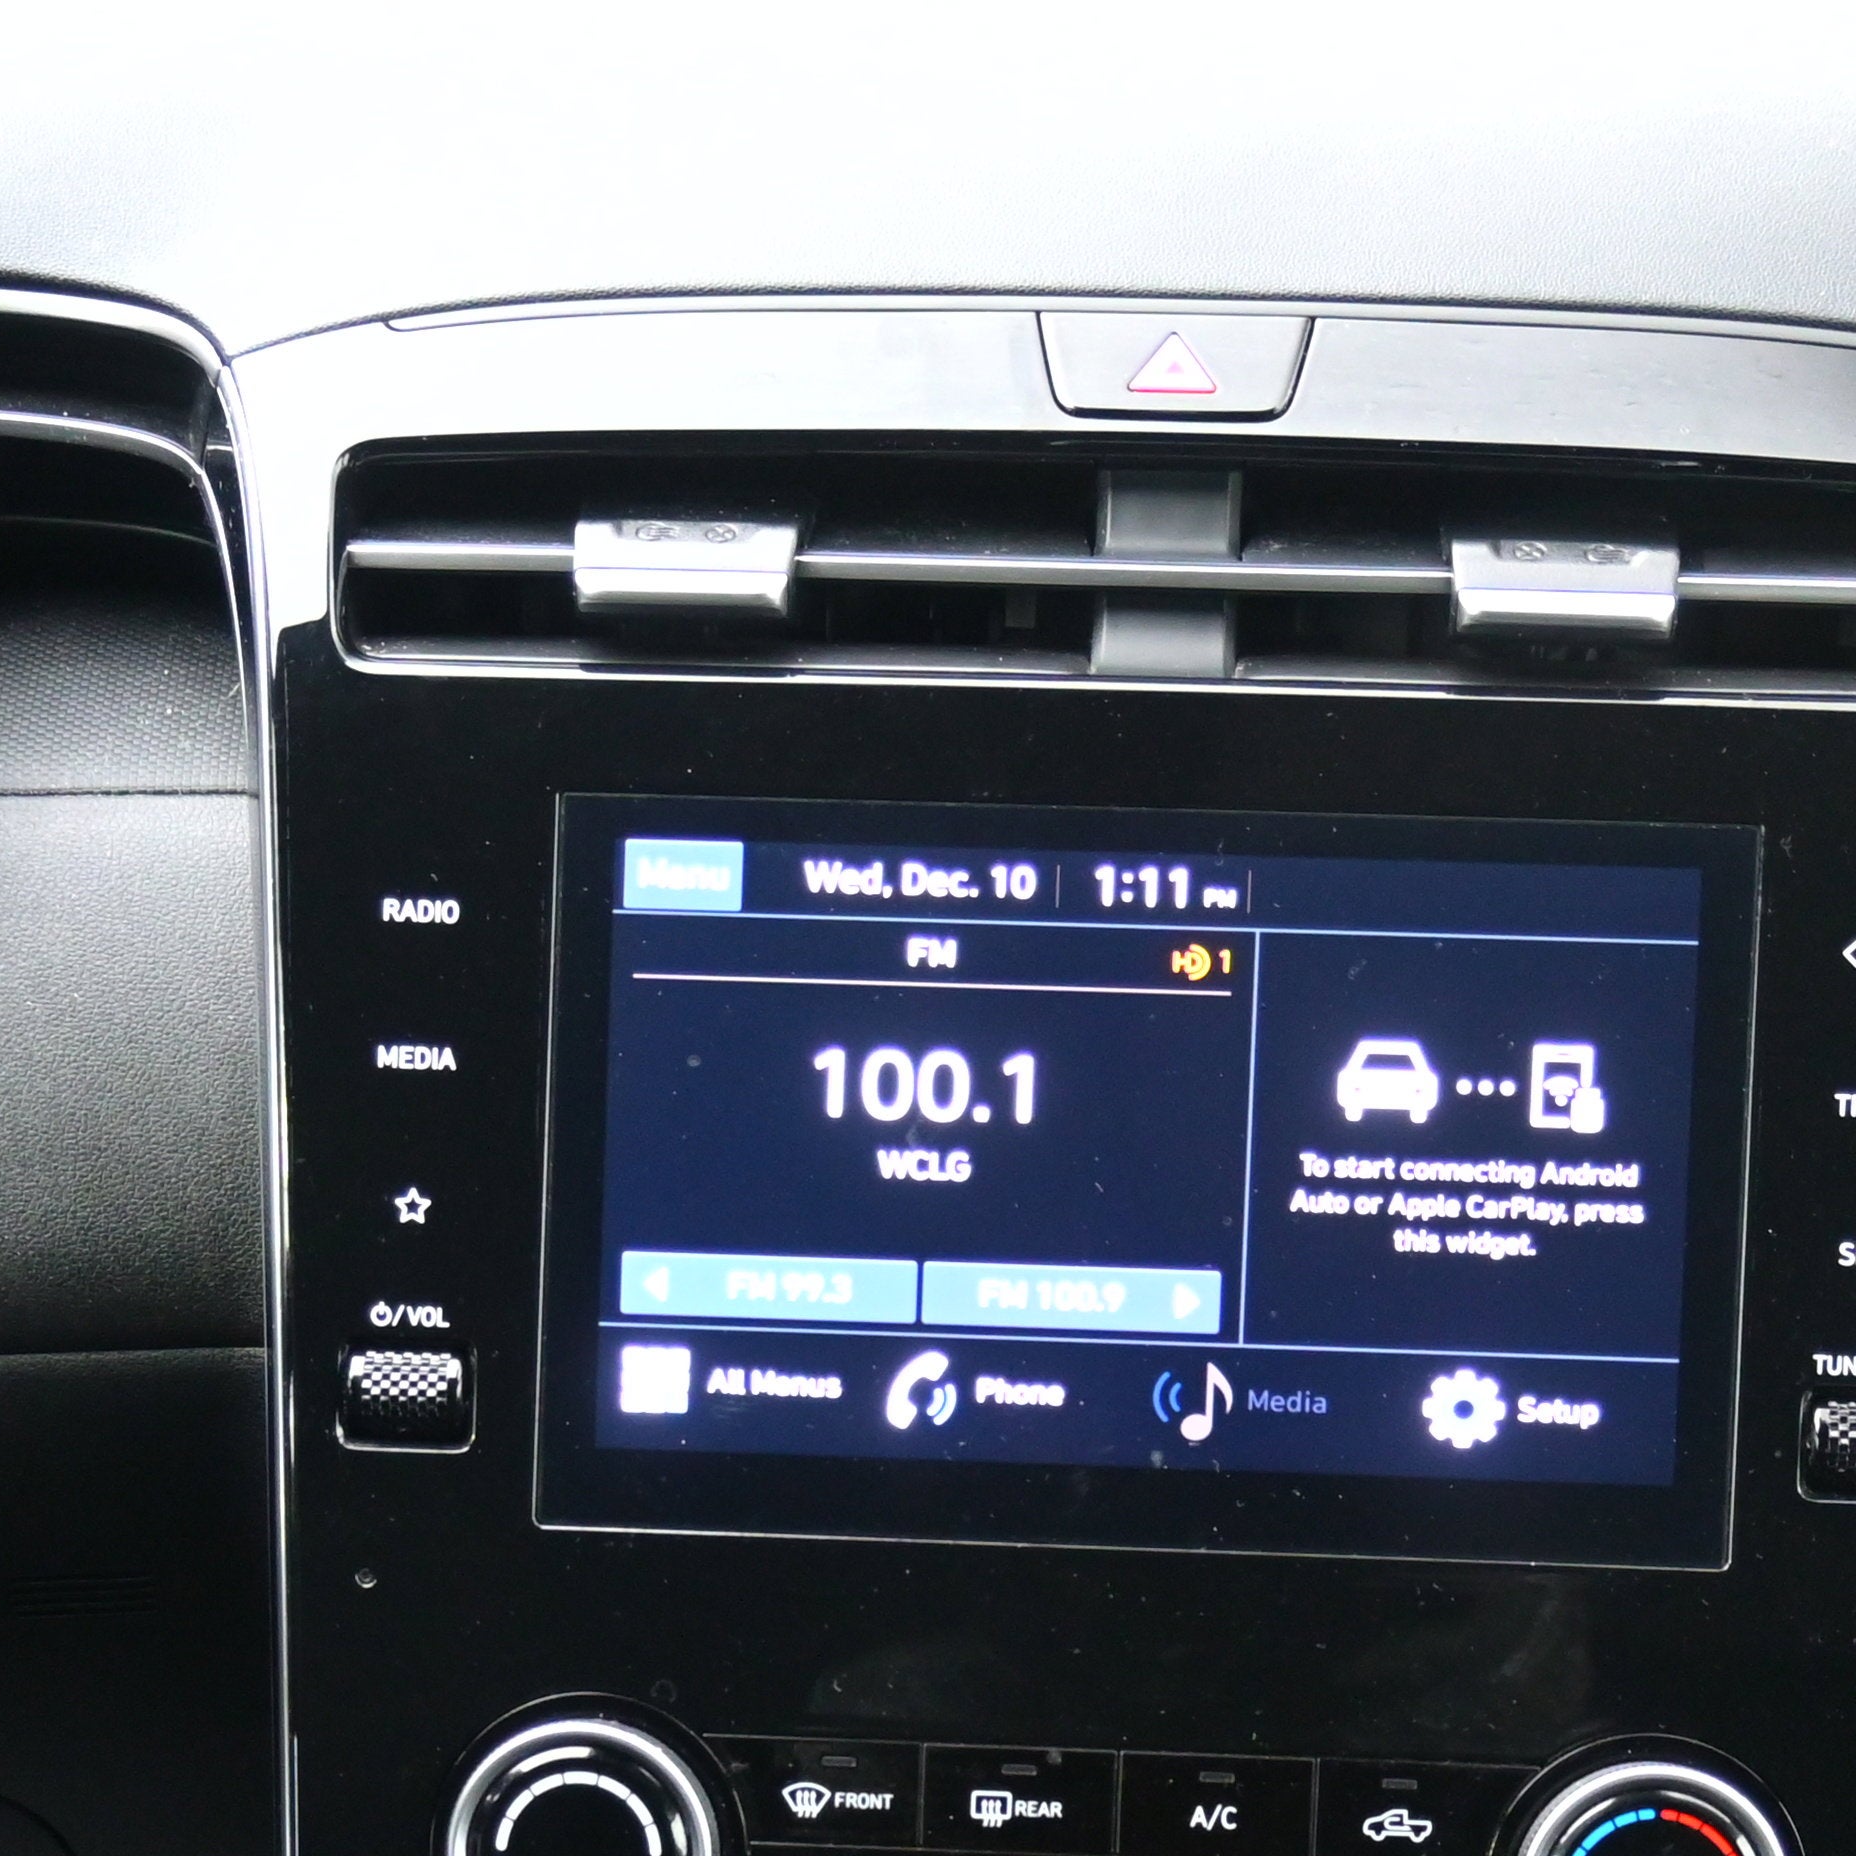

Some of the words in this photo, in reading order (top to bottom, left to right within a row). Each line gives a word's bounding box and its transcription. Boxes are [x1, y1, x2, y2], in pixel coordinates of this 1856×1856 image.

[804, 860, 892, 898] Wed,
[901, 863, 979, 898] Dec.
[992, 866, 1037, 900] 10
[1095, 864, 1189, 908] 1:11
[1203, 887, 1237, 909] PM
[383, 898, 460, 924] RADIO
[907, 938, 957, 968] FM
[377, 1045, 457, 1071] MEDIA
[814, 1046, 1035, 1125] 100.1
[877, 1150, 972, 1182] WCLG
[1300, 1153, 1329, 1178] To
[1334, 1156, 1395, 1180] start
[1400, 1159, 1536, 1189] connecting
[1540, 1162, 1638, 1187] Android
[1290, 1190, 1349, 1214] Auto
[1354, 1196, 1383, 1215] or
[1388, 1192, 1461, 1220] Apple
[1574, 1202, 1644, 1226] press
[1393, 1229, 1441, 1253] this
[1446, 1232, 1536, 1260] widget.
[707, 1368, 746, 1396] All
[751, 1370, 843, 1399] Menus
[975, 1377, 1065, 1406] Phone
[1248, 1390, 1327, 1415] Media
[1517, 1397, 1600, 1429] Setup
[834, 1792, 894, 1810] FRONT
[1015, 1800, 1062, 1818] REAR
[1190, 1805, 1238, 1831] A/C
